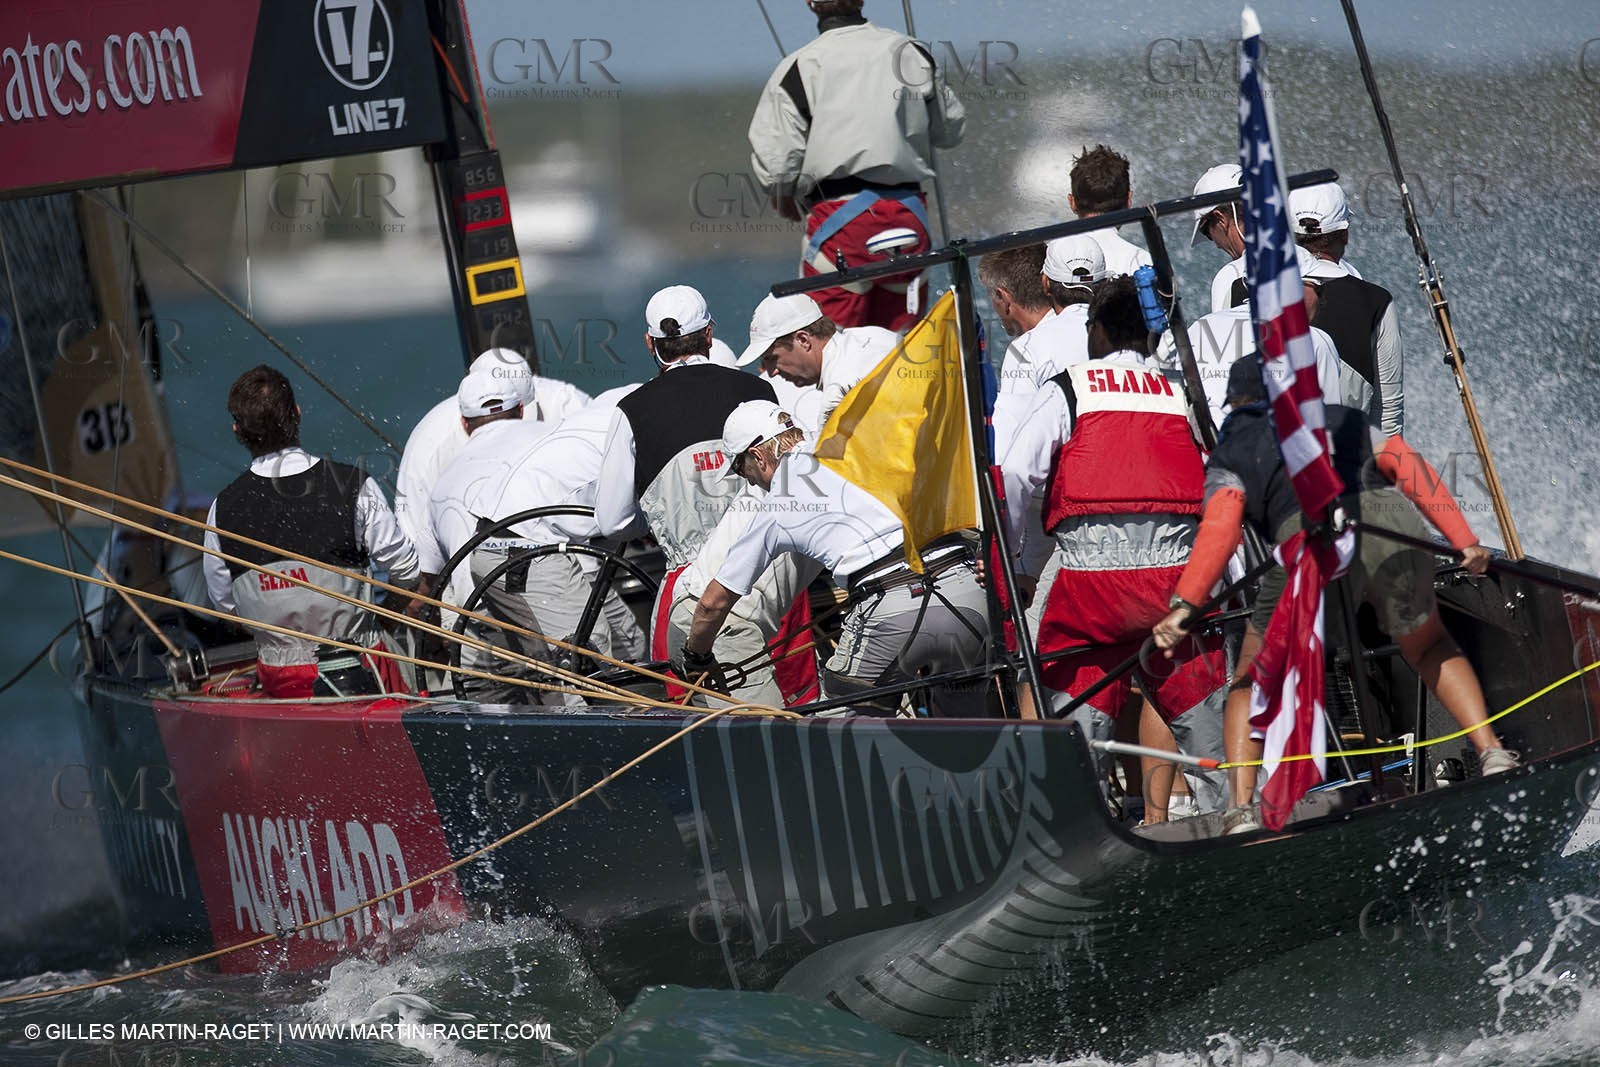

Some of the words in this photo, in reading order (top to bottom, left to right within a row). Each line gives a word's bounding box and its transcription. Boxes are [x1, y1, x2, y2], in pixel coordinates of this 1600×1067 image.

[0, 26, 204, 122] ates.com
[1086, 368, 1174, 397] SLAM
[693, 449, 725, 472] SLA
